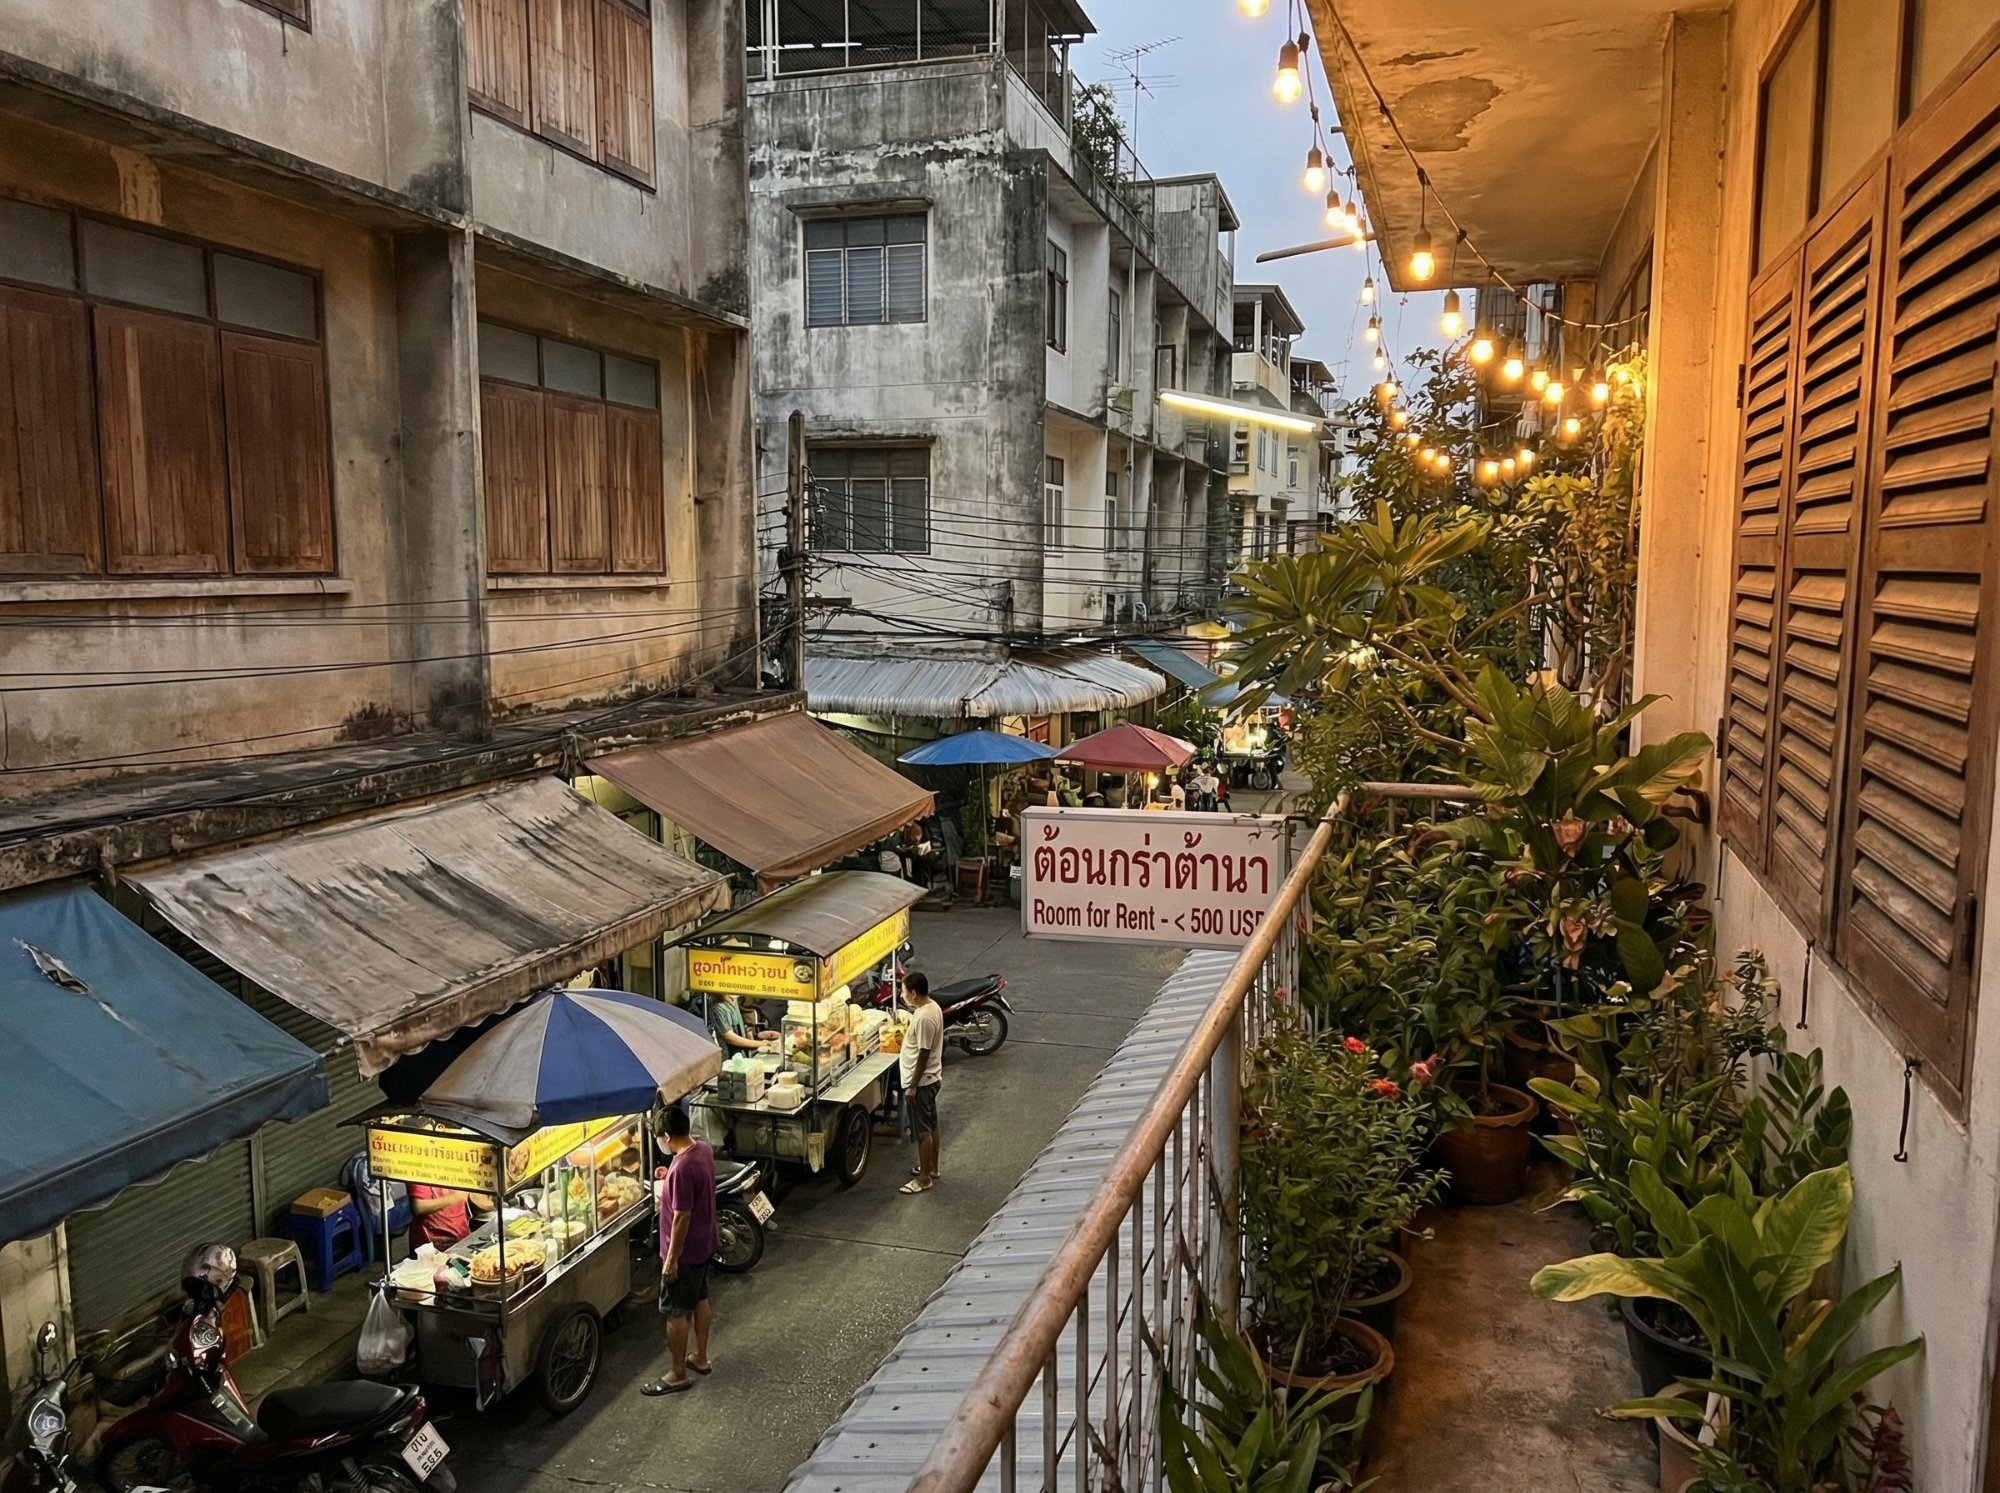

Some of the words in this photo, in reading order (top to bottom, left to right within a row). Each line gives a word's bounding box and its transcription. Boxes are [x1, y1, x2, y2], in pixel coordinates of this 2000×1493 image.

[1034, 898, 1081, 926] Room
[1087, 901, 1110, 928] for
[1116, 903, 1155, 931] Rent
[1174, 913, 1186, 932] <
[1190, 908, 1224, 935] 500
